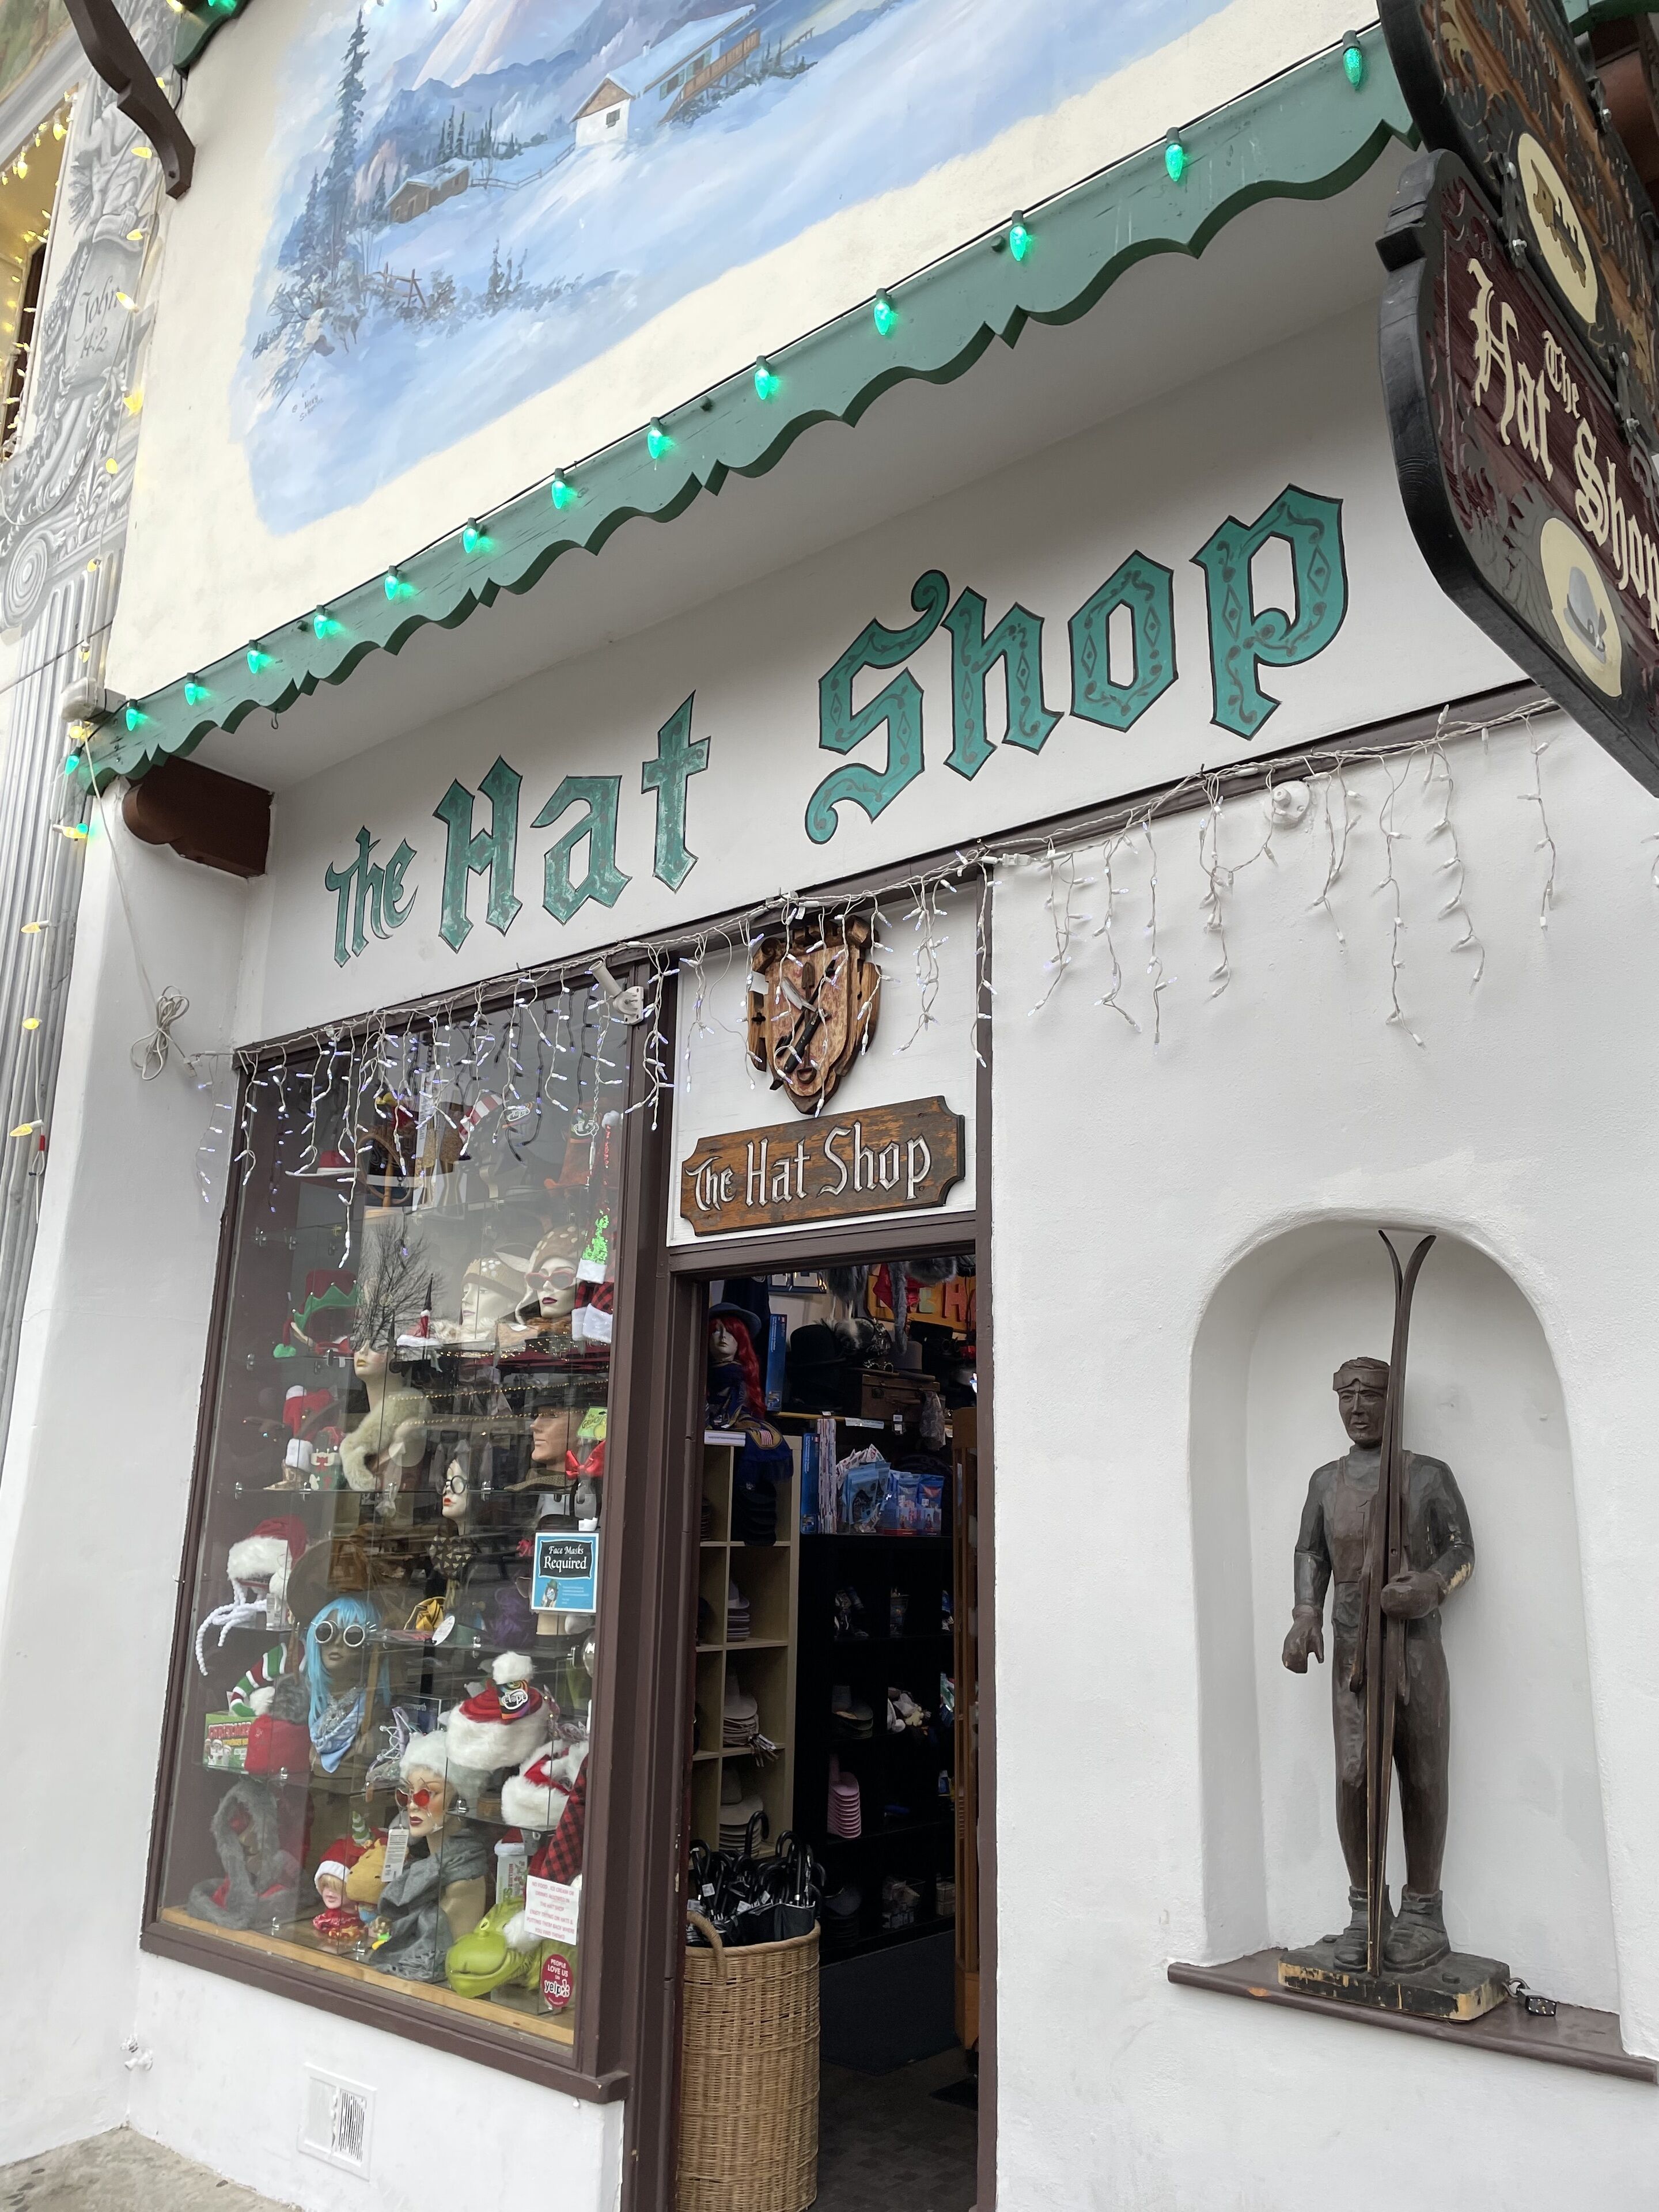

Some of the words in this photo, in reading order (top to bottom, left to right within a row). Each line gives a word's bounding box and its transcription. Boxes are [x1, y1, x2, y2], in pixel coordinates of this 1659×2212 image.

[1467, 257, 1553, 480] Hat
[1543, 329, 1580, 419] The
[431, 689, 712, 953] Hat
[805, 482, 1350, 845] Shop
[684, 1156, 736, 1212] The
[745, 1137, 811, 1207] Hat
[815, 1120, 932, 1201] Shop
[548, 1546, 563, 1555] Face
[564, 1544, 584, 1555] Masks
[543, 1555, 588, 1573] Required
[547, 1964, 560, 1975] LOVE
[561, 1969, 569, 1977] US
[550, 1959, 566, 1969] PEOPLE
[544, 1980, 562, 1997] yelp
